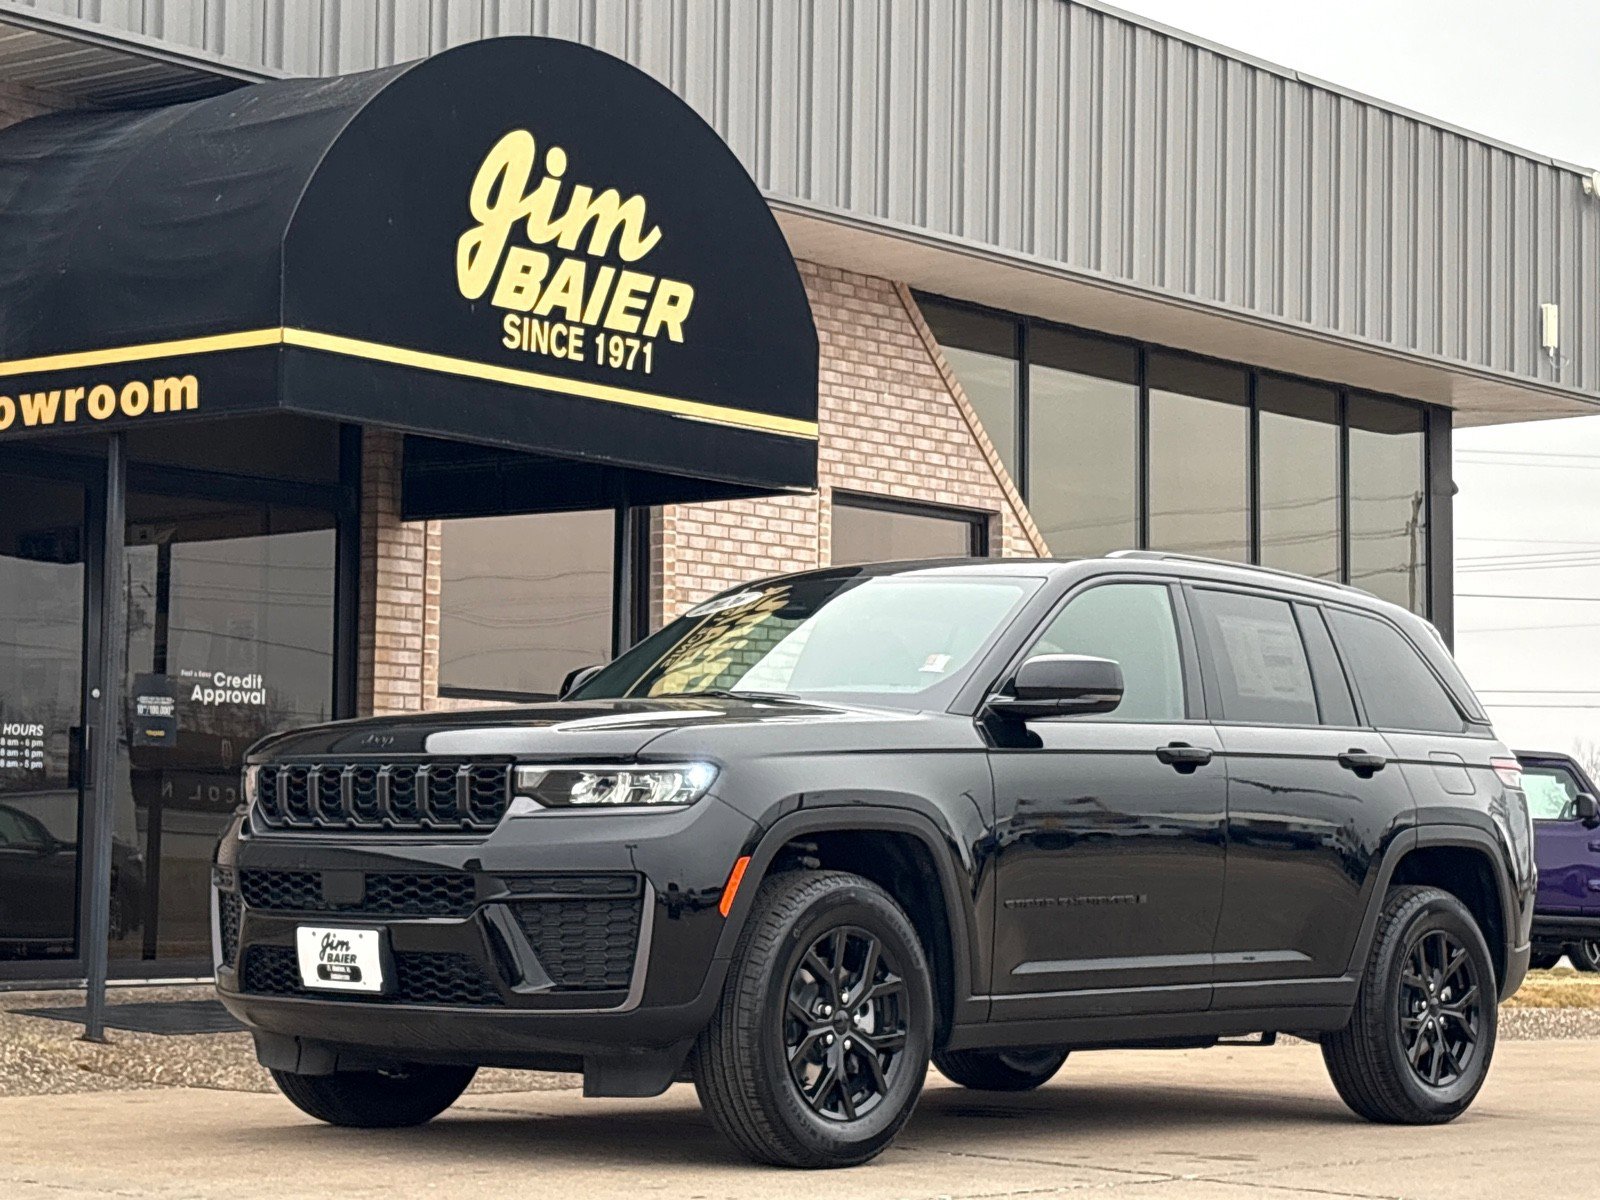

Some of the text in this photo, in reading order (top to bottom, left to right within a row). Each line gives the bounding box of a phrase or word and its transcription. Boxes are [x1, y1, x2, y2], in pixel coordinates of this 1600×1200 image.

[456, 128, 663, 300] Jim
[491, 245, 695, 344] BAIER
[502, 313, 653, 374] SINCE 1971
[213, 671, 263, 690] Credit
[191, 684, 266, 706] Approval
[3, 723, 44, 737] HOURS
[6, 749, 19, 757] am
[31, 750, 44, 759] pm
[31, 740, 44, 749] pm
[6, 760, 19, 768] am
[31, 761, 43, 770] pm
[319, 932, 351, 961] Jim
[327, 953, 357, 963] BAIER
